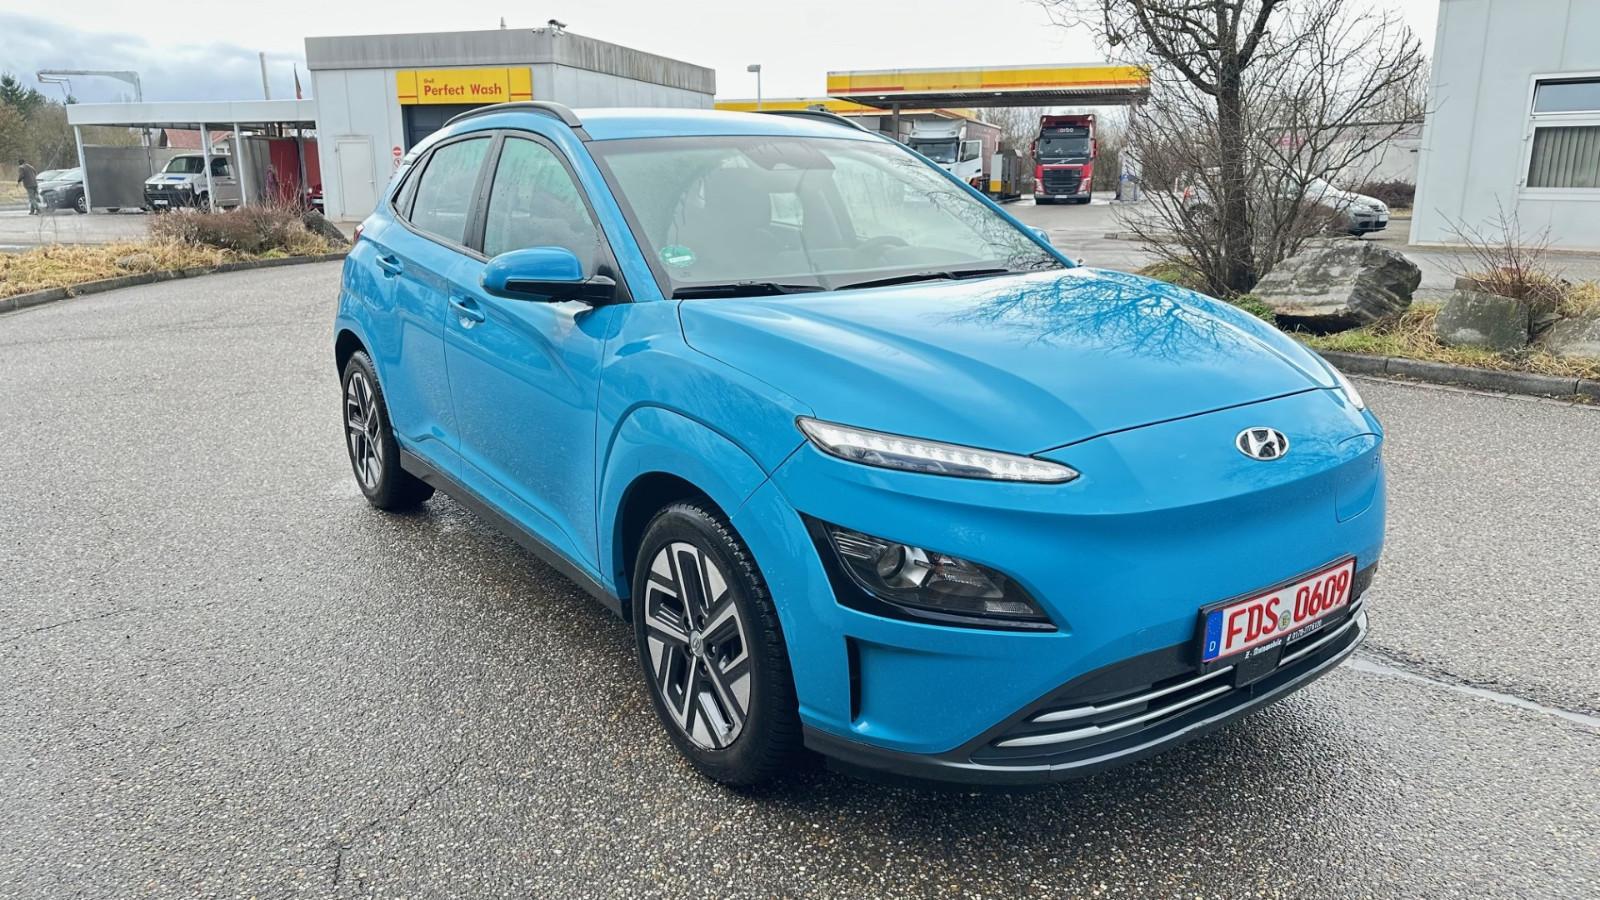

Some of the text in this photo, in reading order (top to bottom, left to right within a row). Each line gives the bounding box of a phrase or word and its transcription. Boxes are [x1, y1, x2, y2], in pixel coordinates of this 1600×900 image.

[424, 83, 502, 96] Perfect Wash
[1208, 641, 1217, 652] D
[1225, 597, 1281, 650] FDS
[1293, 569, 1350, 624] 0609
